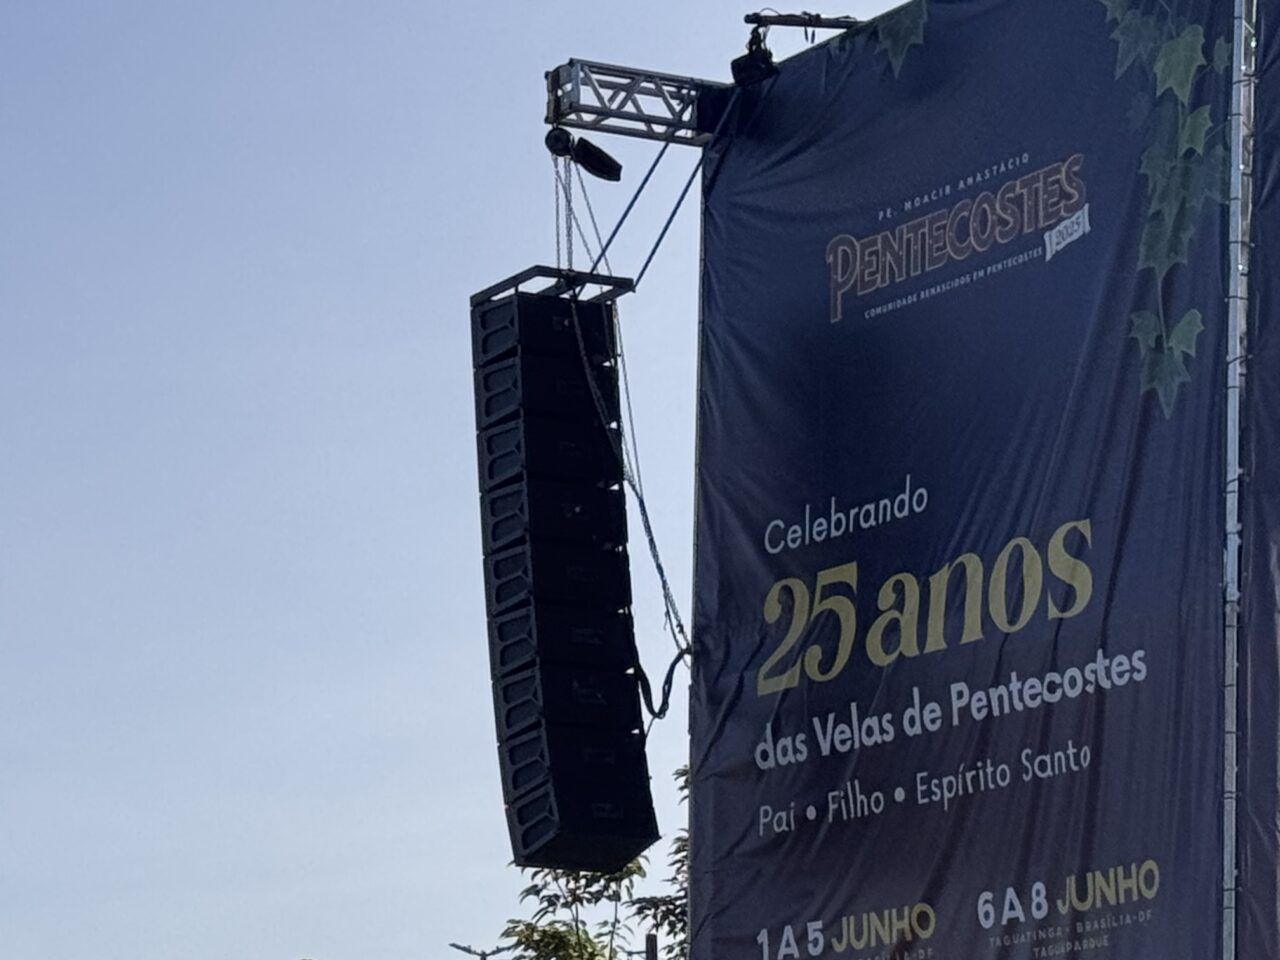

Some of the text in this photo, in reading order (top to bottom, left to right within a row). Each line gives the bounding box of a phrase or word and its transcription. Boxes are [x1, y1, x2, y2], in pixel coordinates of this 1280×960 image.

[958, 152, 1031, 192] ANASTÁCIO
[826, 153, 1087, 324] PENTECOSTES
[864, 245, 1043, 320] COMUNIDADE RENASCIDOS EM PENTECOSTES
[764, 474, 929, 555] Celebrando
[757, 518, 1094, 697] 25 anos
[754, 647, 1148, 771] das Velas de Pentecostes
[758, 740, 1092, 838] Pai Filho Espírito Santo
[806, 919, 825, 957] 5
[831, 902, 937, 953] JUNHO
[977, 890, 996, 930] 6
[1030, 880, 1049, 921] 8
[1056, 858, 1161, 916] JUNHO
